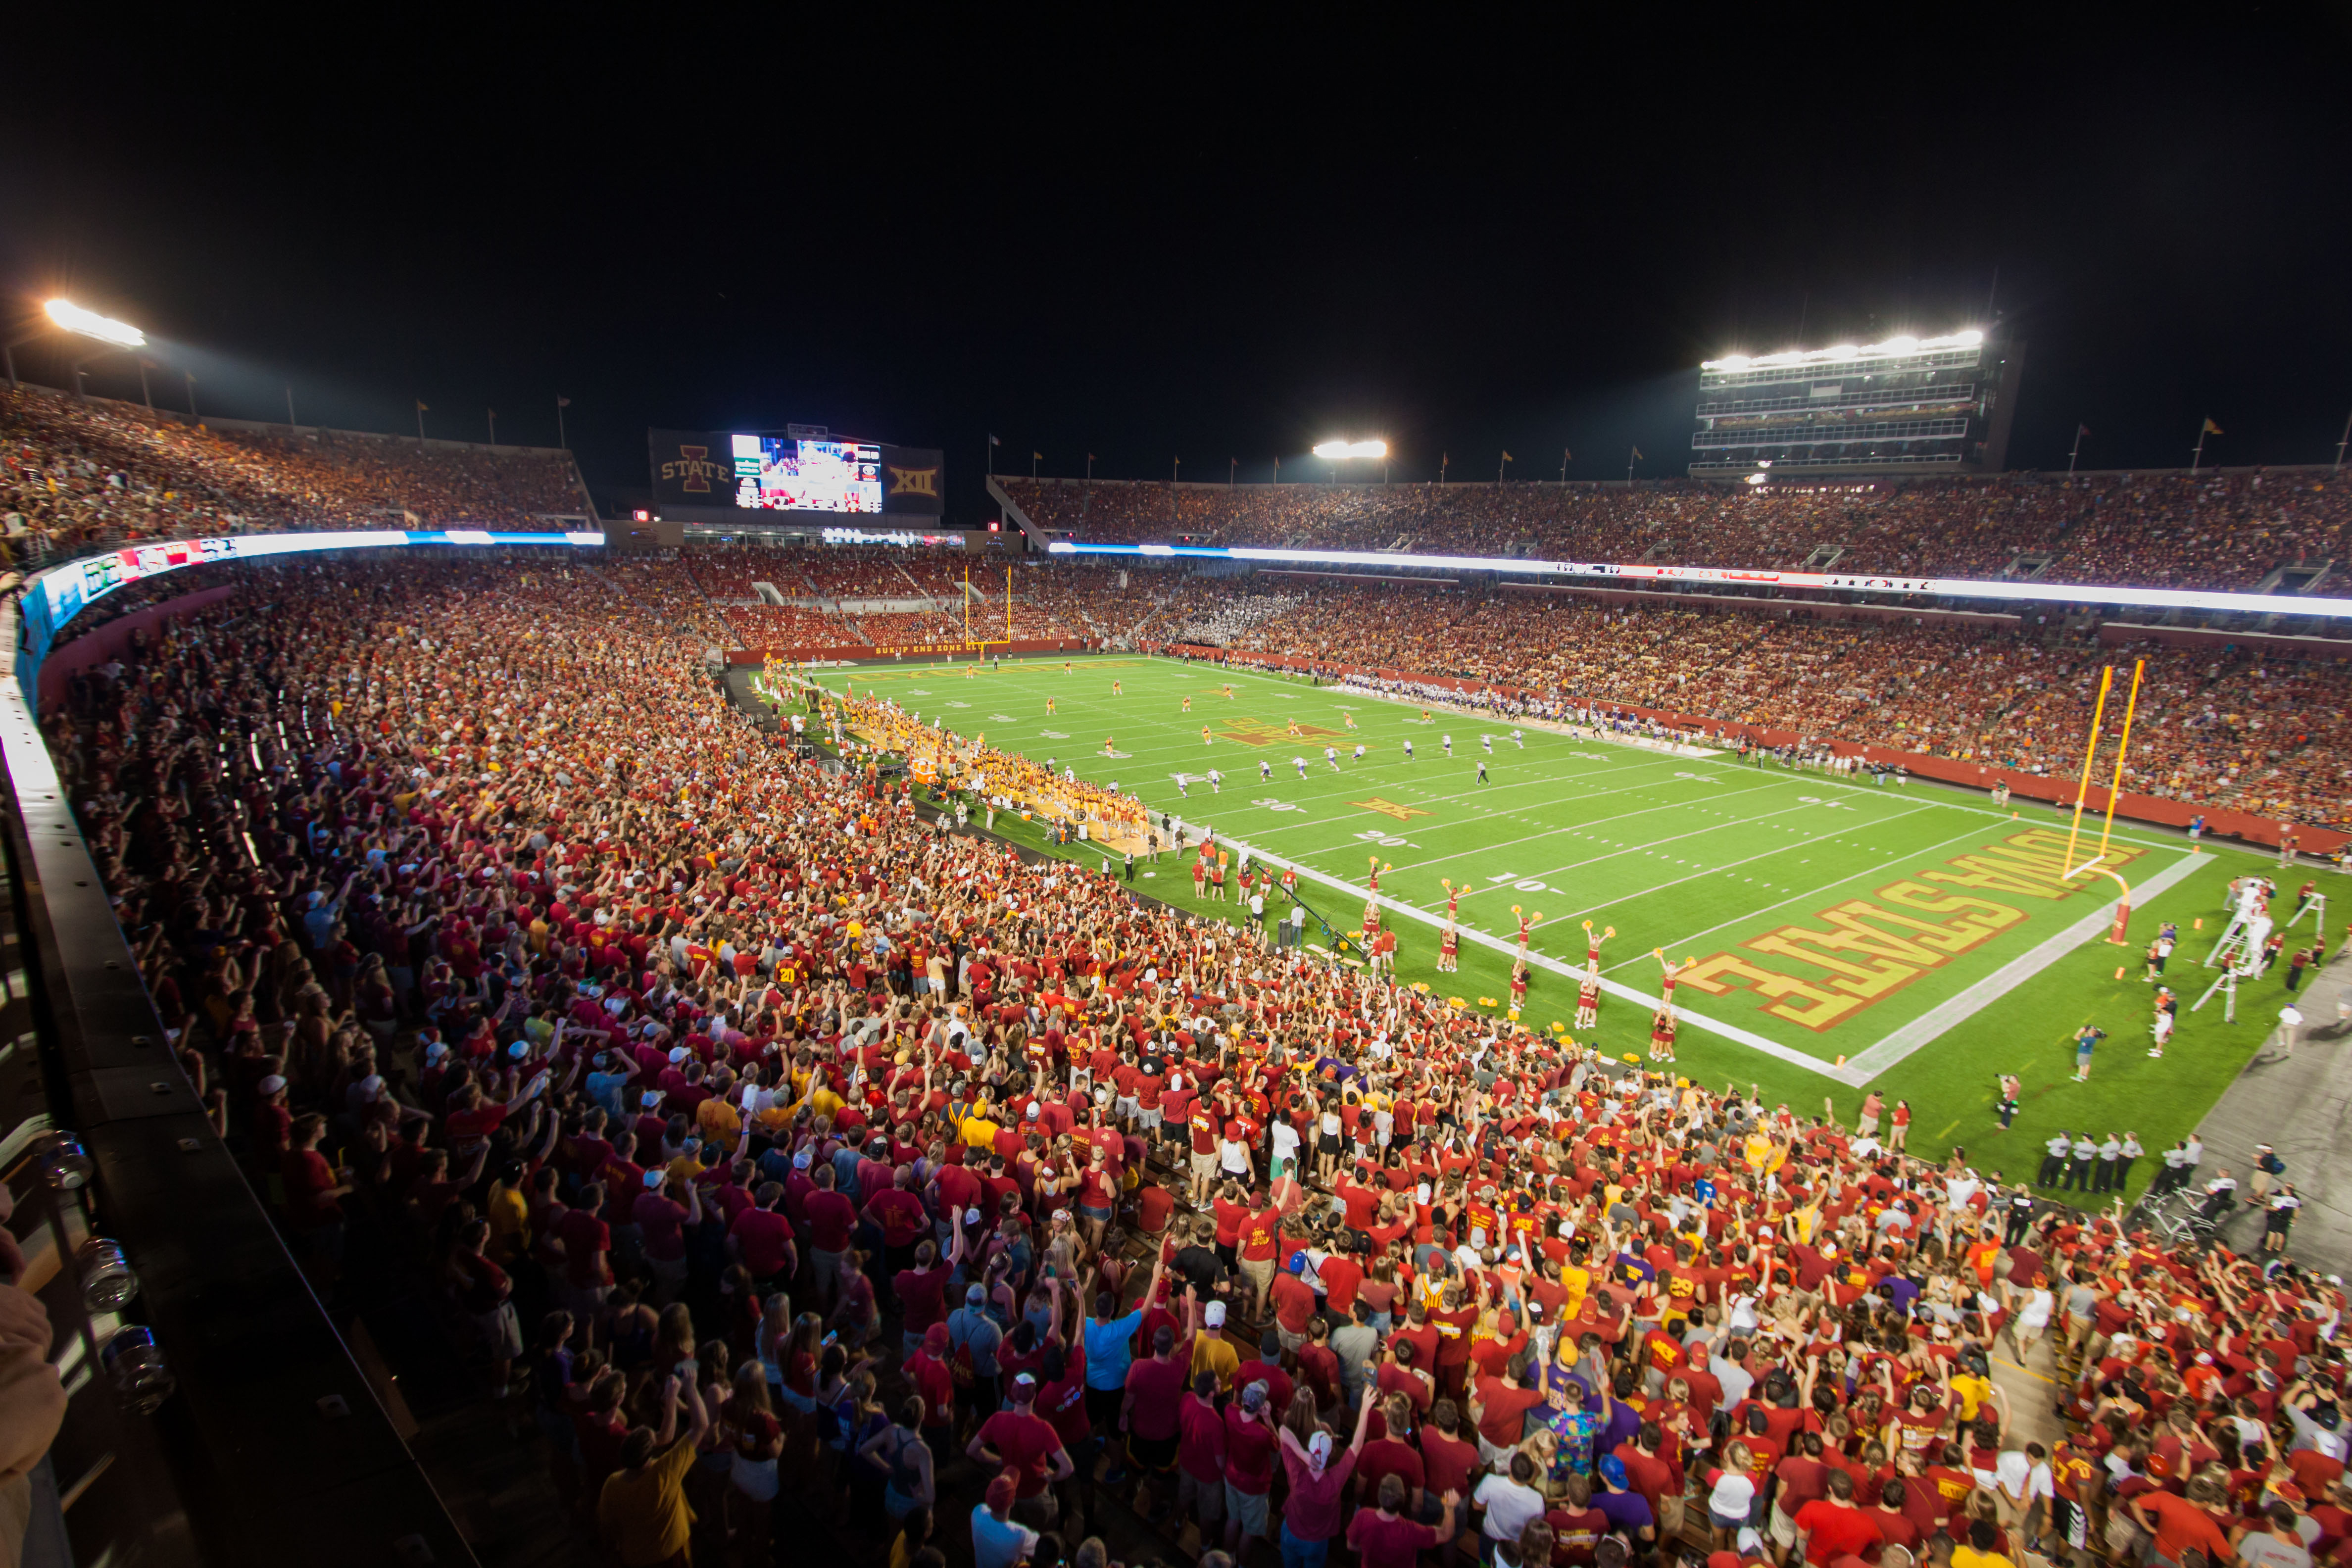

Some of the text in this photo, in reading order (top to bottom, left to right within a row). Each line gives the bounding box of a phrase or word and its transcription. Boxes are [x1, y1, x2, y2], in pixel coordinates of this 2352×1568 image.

[662, 460, 729, 483] STATE
[1251, 798, 1296, 811] 30
[1353, 830, 1407, 846] 20
[1485, 872, 1547, 892] 10
[1660, 828, 2152, 1033] IOWA STATE
[780, 968, 795, 983] 20
